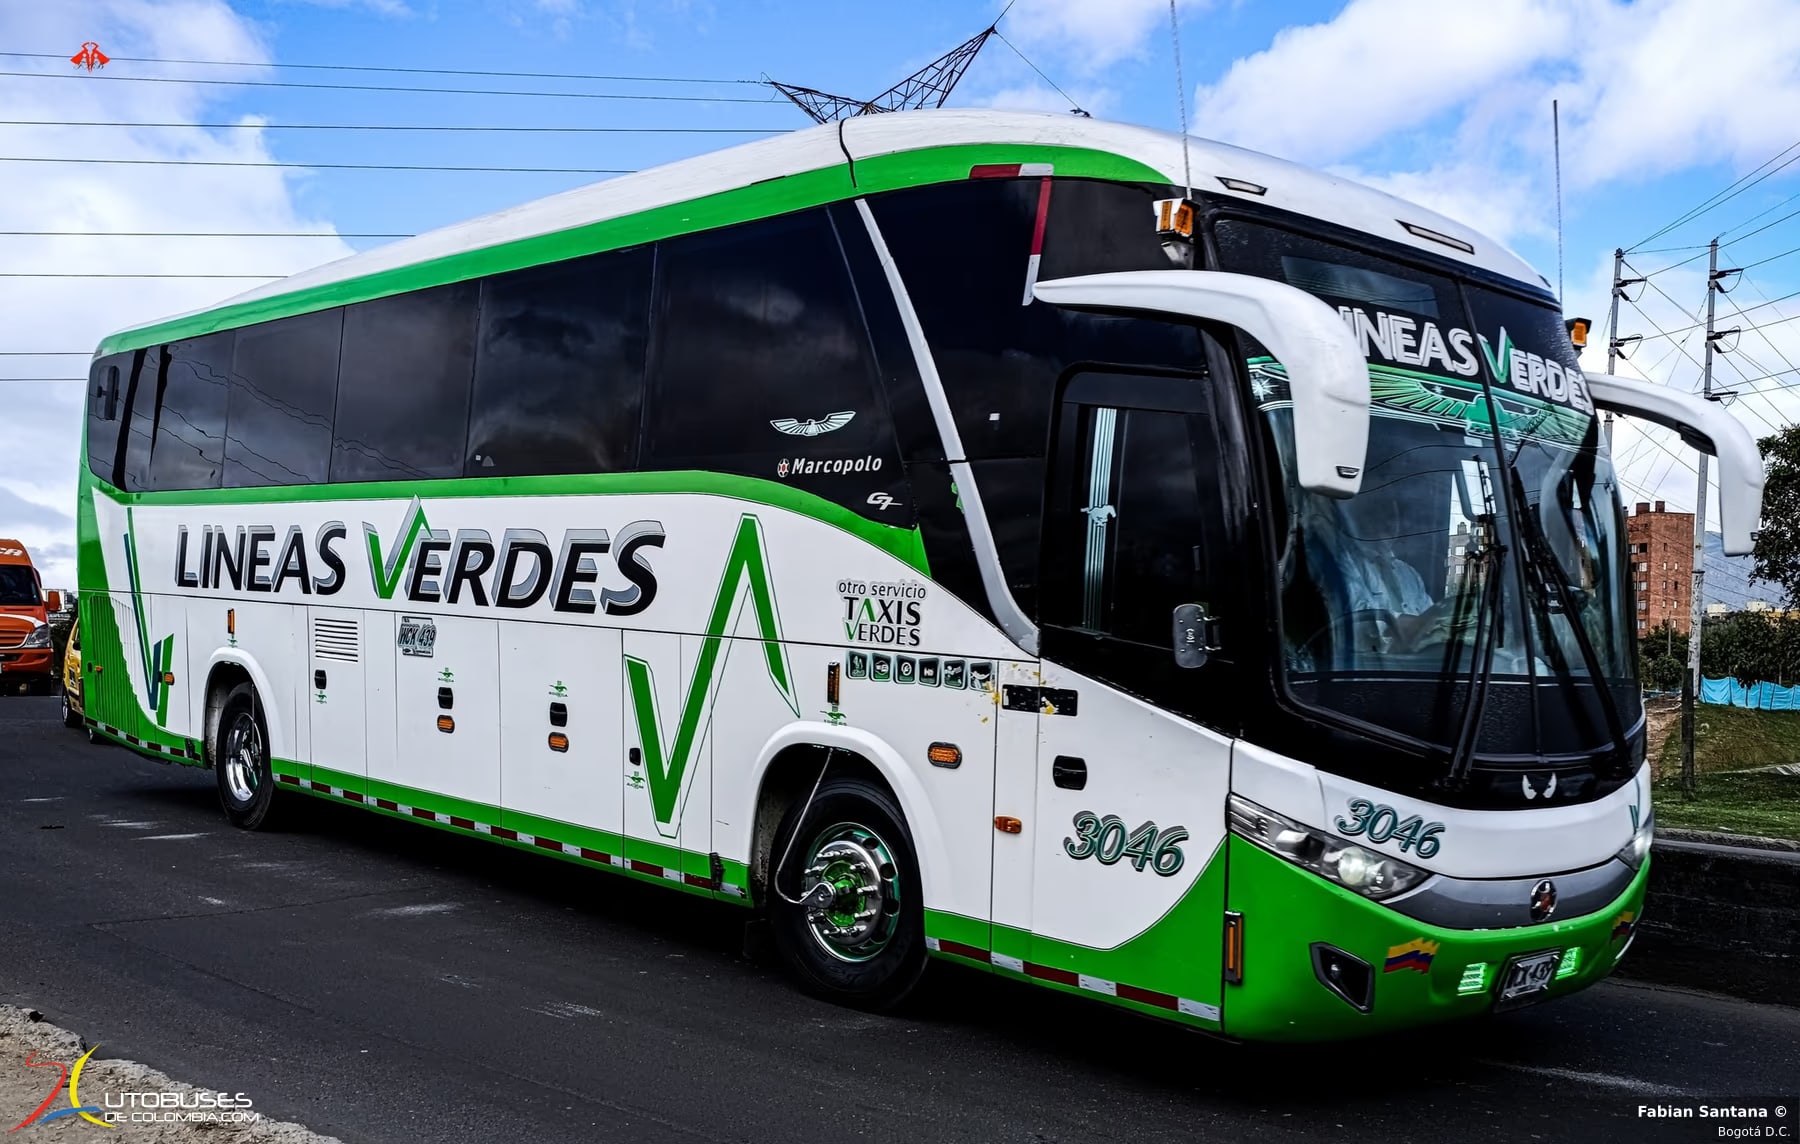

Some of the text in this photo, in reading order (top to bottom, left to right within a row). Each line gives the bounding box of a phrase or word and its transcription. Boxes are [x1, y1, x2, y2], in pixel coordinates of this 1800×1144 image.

[1338, 306, 1479, 376] INEAS
[791, 455, 882, 475] Marcopolo
[175, 493, 666, 617] LINEAS VERDES
[838, 581, 926, 599] otro servicio
[843, 596, 921, 627] TAXIS
[418, 625, 437, 648] 439
[845, 622, 920, 647] VERDES
[1063, 810, 1189, 877] 3046
[1334, 798, 1446, 859] 3046
